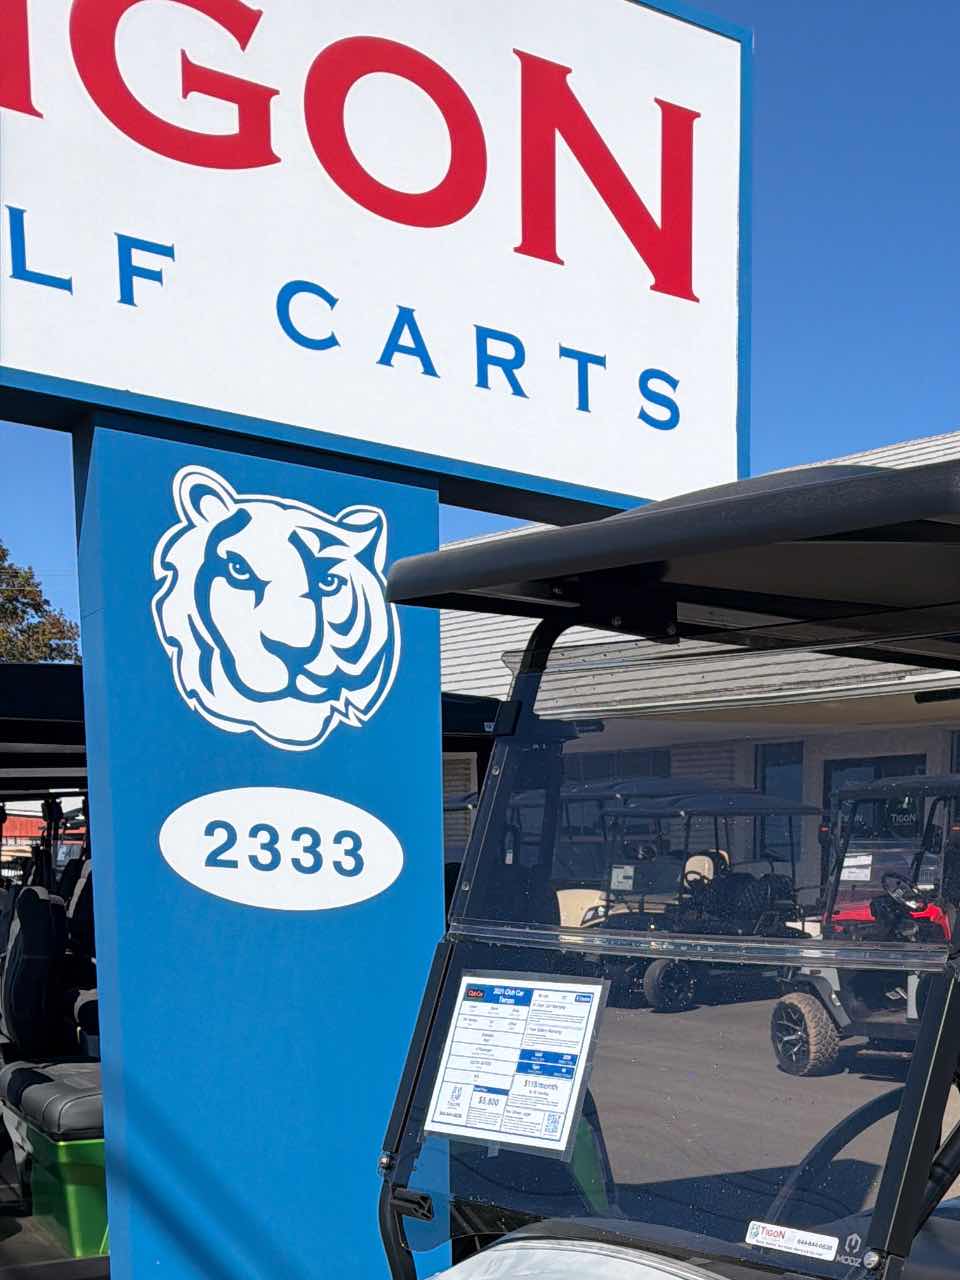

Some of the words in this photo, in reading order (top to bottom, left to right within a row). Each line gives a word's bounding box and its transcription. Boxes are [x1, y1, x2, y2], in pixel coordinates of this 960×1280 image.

[275, 279, 681, 431] CARTS
[203, 819, 365, 877] 2333
[759, 1226, 786, 1240] TIGON
[836, 1254, 862, 1268] MODZ
